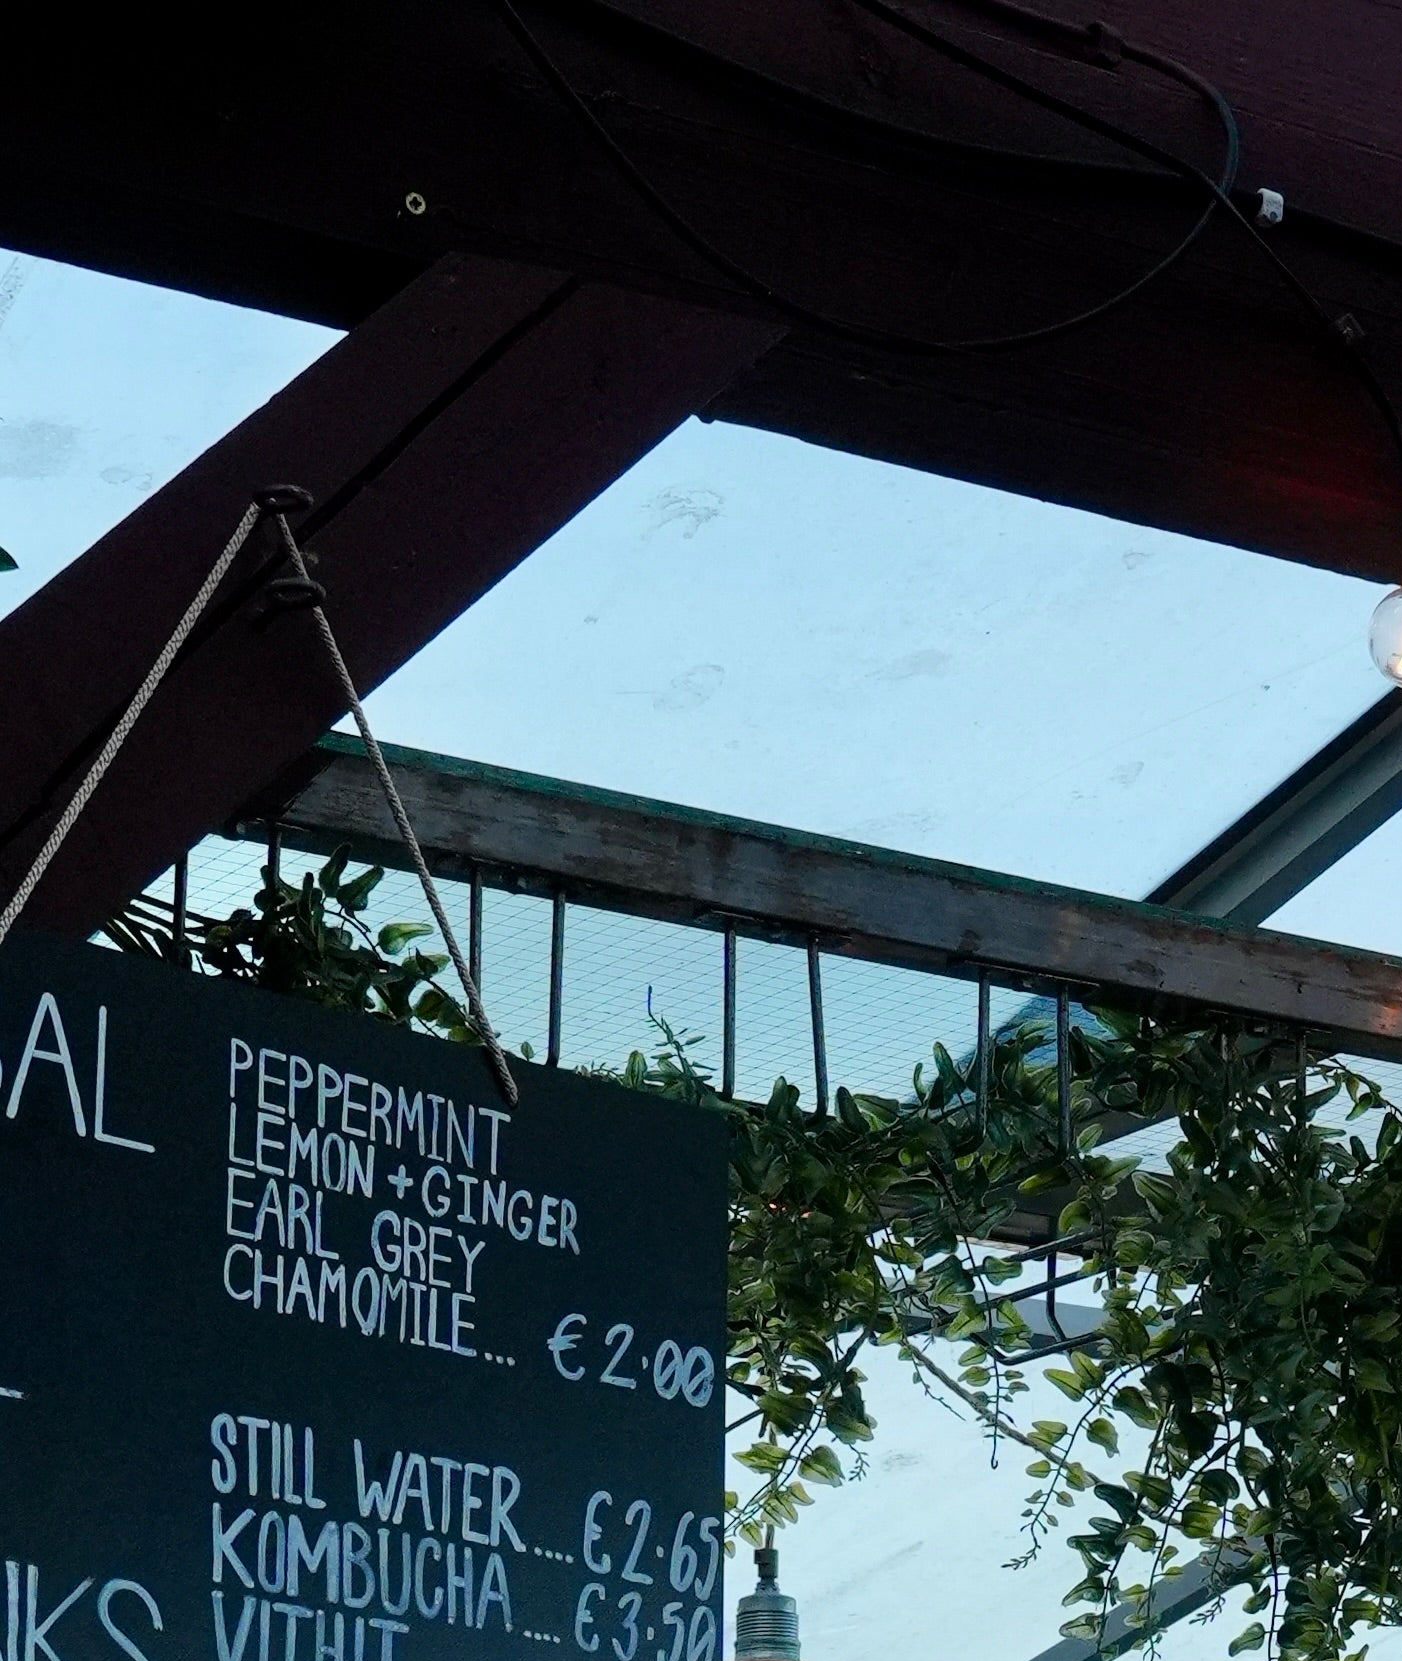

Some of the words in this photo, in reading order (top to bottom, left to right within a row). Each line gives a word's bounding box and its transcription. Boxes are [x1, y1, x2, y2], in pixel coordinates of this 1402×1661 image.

[0, 992, 155, 1153] AL
[229, 1038, 511, 1175] PEPPERMINT
[227, 1167, 339, 1260] EARL
[372, 1209, 486, 1294] GREY
[229, 1111, 376, 1198] LEMON
[421, 1165, 580, 1255] GINGER
[211, 1413, 326, 1509] STILL
